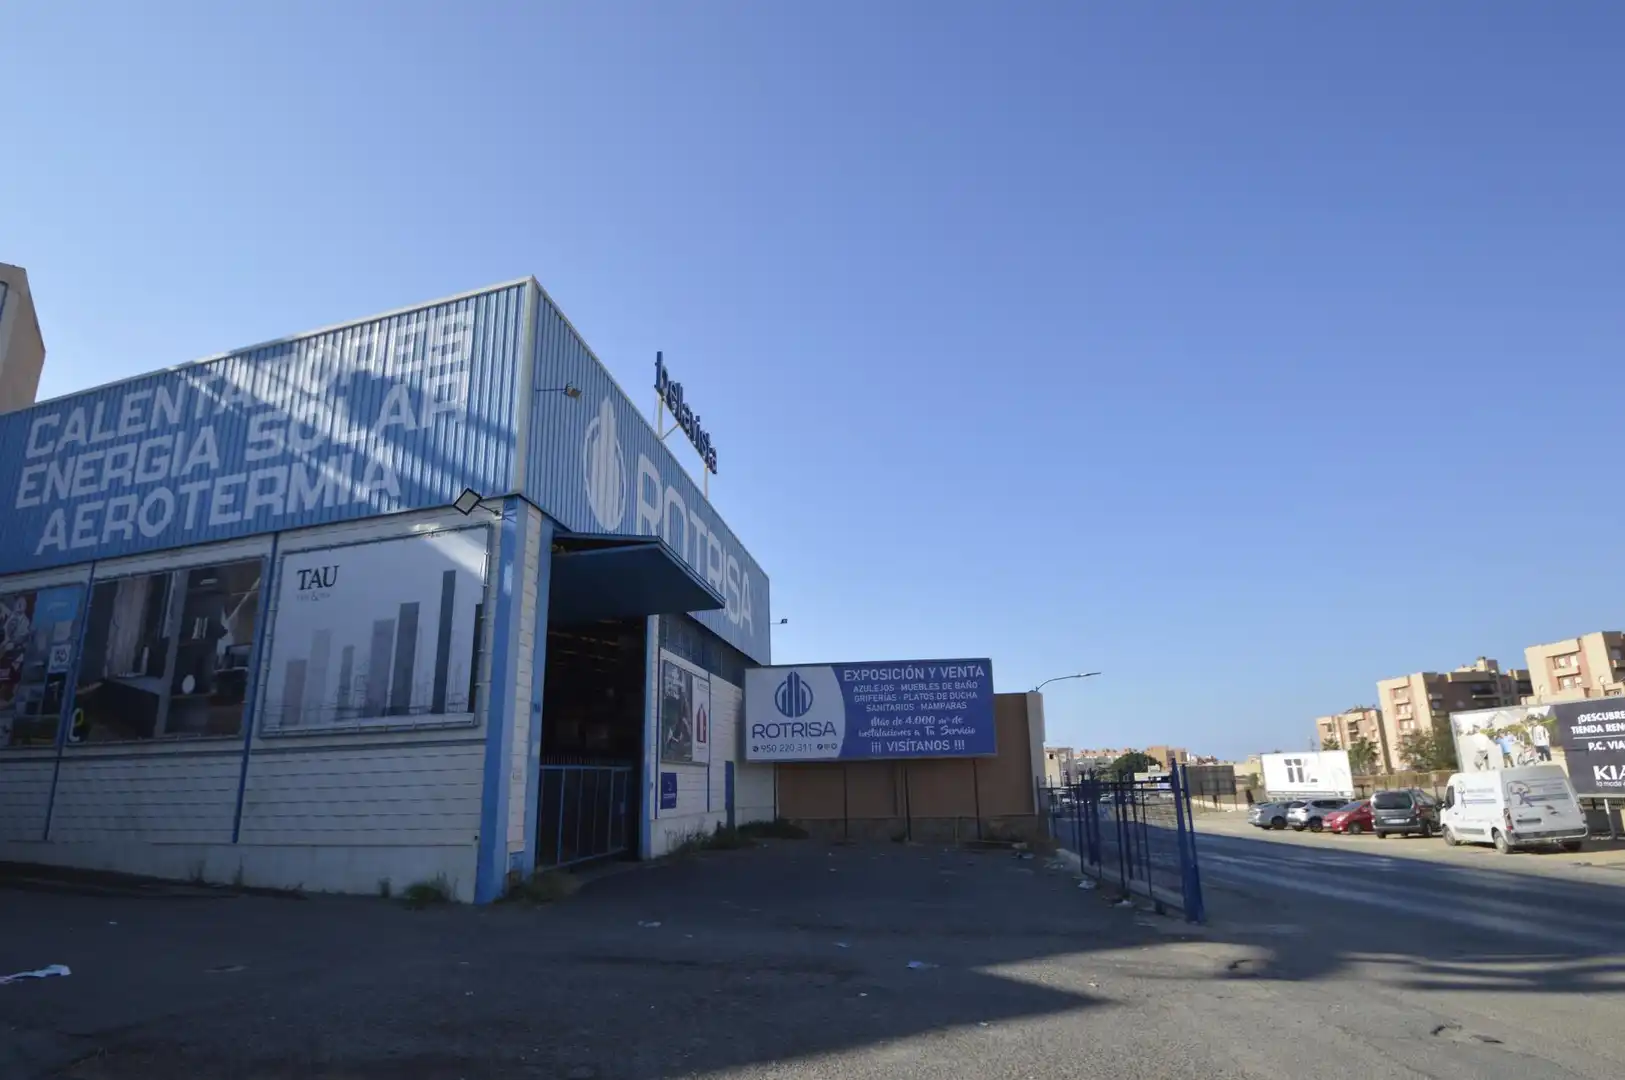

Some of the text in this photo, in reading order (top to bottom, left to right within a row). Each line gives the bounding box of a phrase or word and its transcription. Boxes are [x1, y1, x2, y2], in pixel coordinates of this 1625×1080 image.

[15, 371, 469, 509] ENERGIA SOLAR
[33, 445, 401, 556] AEROTERMIA
[636, 453, 753, 636] ROTRISA
[296, 565, 339, 591] TAU
[843, 665, 985, 681] EXPOSICIÓN Y VENTA
[853, 680, 978, 693] AZULEJOS MUEBLES DE BAÑO
[903, 692, 934, 701] PLATOS
[936, 691, 949, 700] DE
[949, 690, 978, 700] DUCHA
[866, 701, 967, 712] SANITARIOS MAMPARAS
[904, 715, 936, 725] 4.000
[751, 719, 837, 739] ROTRISA
[1570, 724, 1605, 735] TIENDA
[760, 743, 777, 753] 950
[886, 739, 951, 752] VISÍTANOS
[1588, 741, 1606, 751] P.C.
